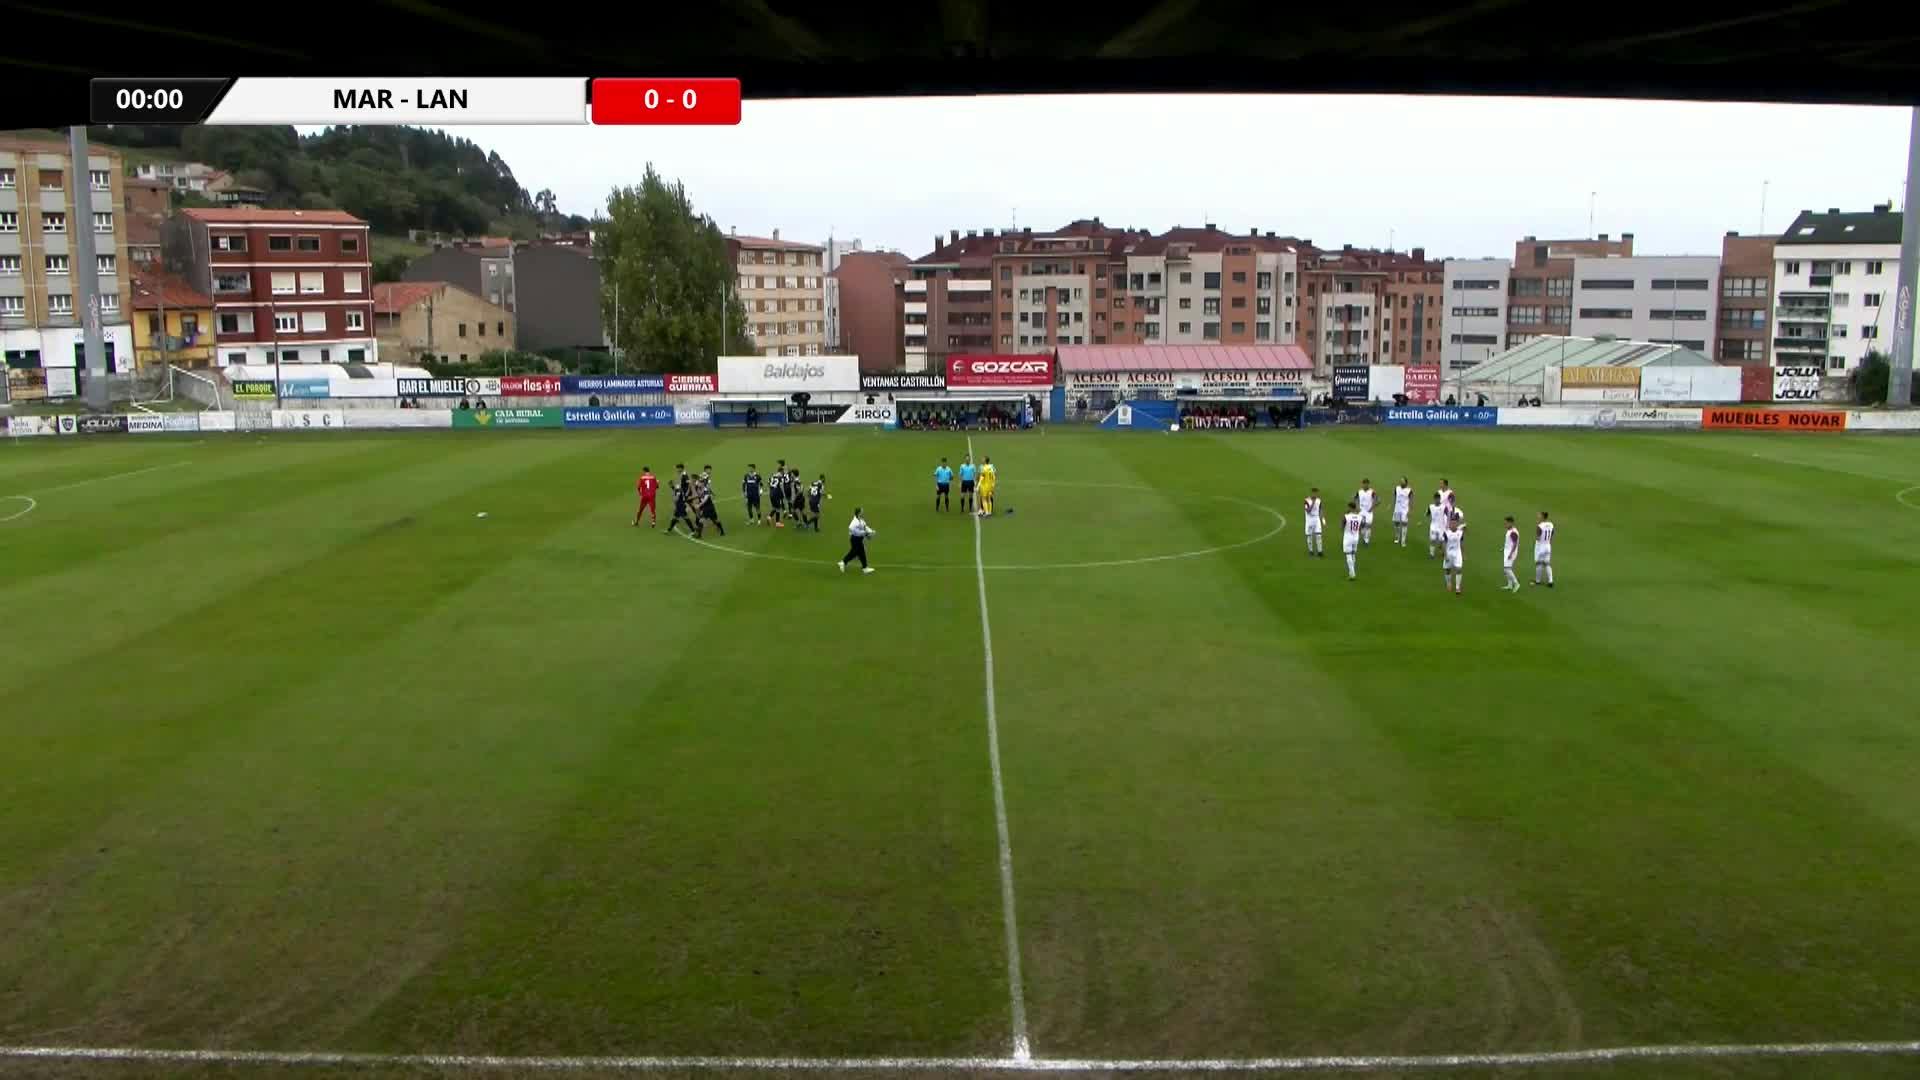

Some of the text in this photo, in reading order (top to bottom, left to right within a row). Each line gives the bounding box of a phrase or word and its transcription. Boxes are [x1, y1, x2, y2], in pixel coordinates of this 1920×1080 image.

[764, 363, 824, 381] Baldajos
[971, 361, 1048, 373] GOZCAR
[1073, 373, 1120, 383] ACESOL
[1128, 373, 1175, 383] ACESOL
[1203, 372, 1249, 381] ACESOL
[1256, 371, 1303, 381] ACESOL
[400, 380, 418, 393] BAR
[418, 380, 429, 393] EL
[429, 380, 464, 393] MUELLE
[579, 379, 664, 389] HIERROS LAMINADOS ASTURIAS
[862, 375, 945, 388] VENTANAS CASTRILLÓN
[566, 410, 600, 421] Estrella
[603, 410, 636, 421] Galicia
[855, 409, 891, 419] SIRGO
[1388, 409, 1424, 420] Estrella
[1425, 410, 1459, 420] Galicia
[1711, 412, 1780, 425] MUEBLES
[1789, 414, 1840, 426] NOVAR
[129, 421, 163, 430] MEDINA
